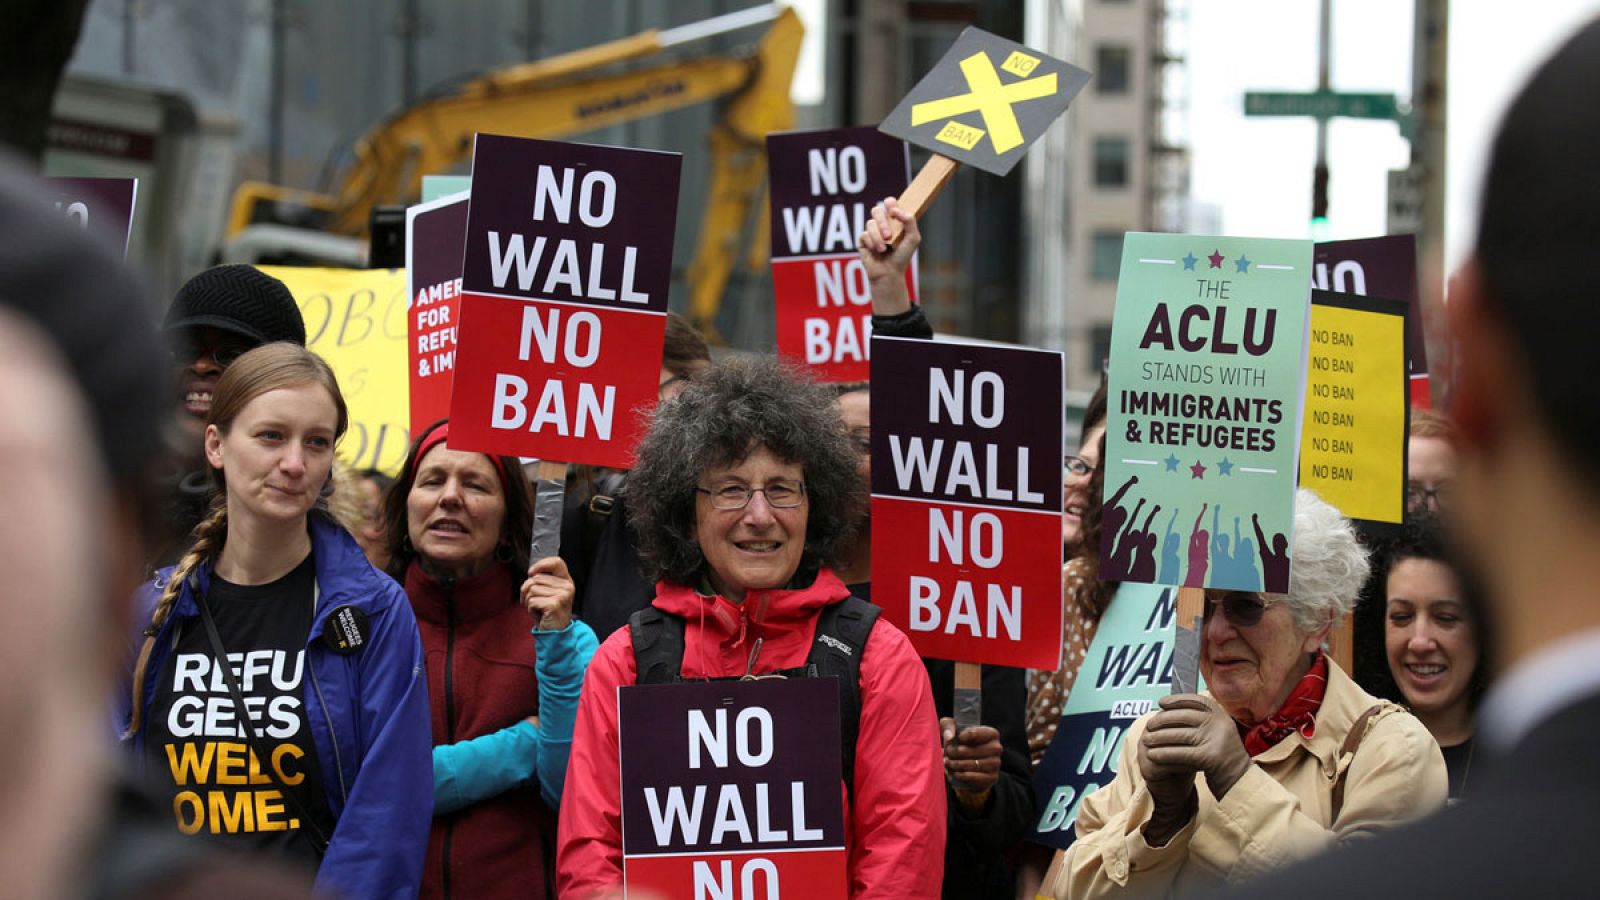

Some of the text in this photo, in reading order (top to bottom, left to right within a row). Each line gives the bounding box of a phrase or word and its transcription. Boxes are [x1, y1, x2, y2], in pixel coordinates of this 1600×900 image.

[1009, 54, 1035, 73] NO
[943, 125, 977, 145] BAN
[808, 145, 867, 196] NO
[532, 164, 617, 228] NO
[782, 202, 864, 253] WAL
[487, 231, 649, 304] WALL
[813, 259, 872, 308] NO
[1196, 279, 1232, 300] THE
[417, 305, 450, 331] FOR
[518, 305, 602, 368] NO
[1139, 302, 1277, 356] ACLU
[1312, 330, 1354, 347] NO BAN
[418, 350, 456, 377] & IM
[1141, 362, 1266, 388] STANDS WITH
[1312, 356, 1354, 374] NO BAN
[491, 373, 617, 441] BAN
[928, 367, 1005, 428] NO
[1120, 389, 1283, 425] IMMIGRANTS
[1312, 383, 1354, 401] NO BAN
[1125, 419, 1276, 453] & REFUGEES
[1312, 410, 1354, 428] NO BAN
[1312, 437, 1354, 454] NO BAN
[888, 434, 1045, 505] WALL
[1312, 464, 1354, 481] NO BAN
[928, 507, 1004, 569] NO
[909, 575, 1023, 641] BAN
[1144, 587, 1177, 633] N
[172, 649, 305, 692] REFU
[167, 695, 301, 738] GEES
[1112, 701, 1150, 717] ACLU
[687, 706, 774, 769] NO
[164, 741, 305, 786] WELC
[172, 789, 300, 835] OME.
[643, 781, 824, 846] WALL
[692, 858, 780, 900] NO
